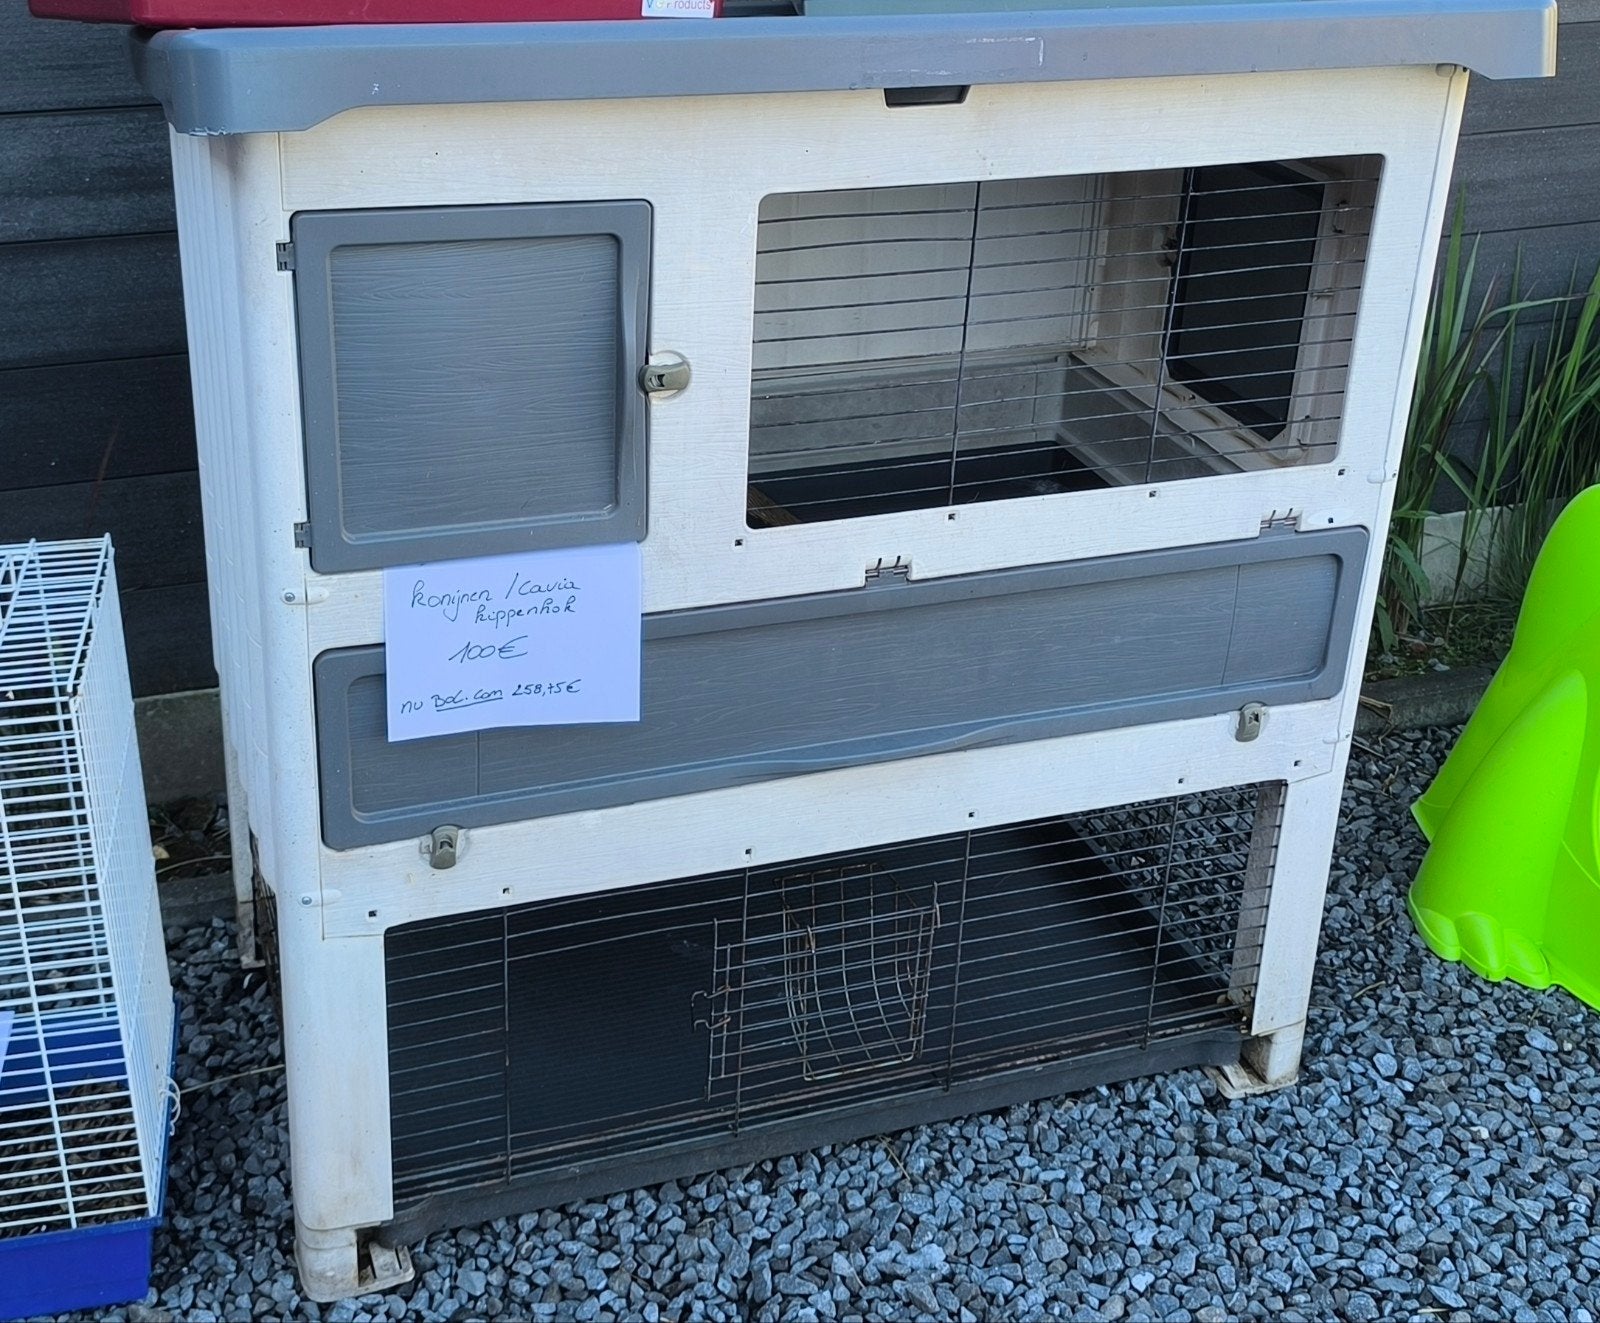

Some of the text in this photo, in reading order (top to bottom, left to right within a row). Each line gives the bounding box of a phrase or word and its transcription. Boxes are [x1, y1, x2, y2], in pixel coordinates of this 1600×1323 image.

[474, 595, 577, 629] kippenhok
[448, 635, 529, 664] 100€
[511, 678, 582, 698] 258,75€
